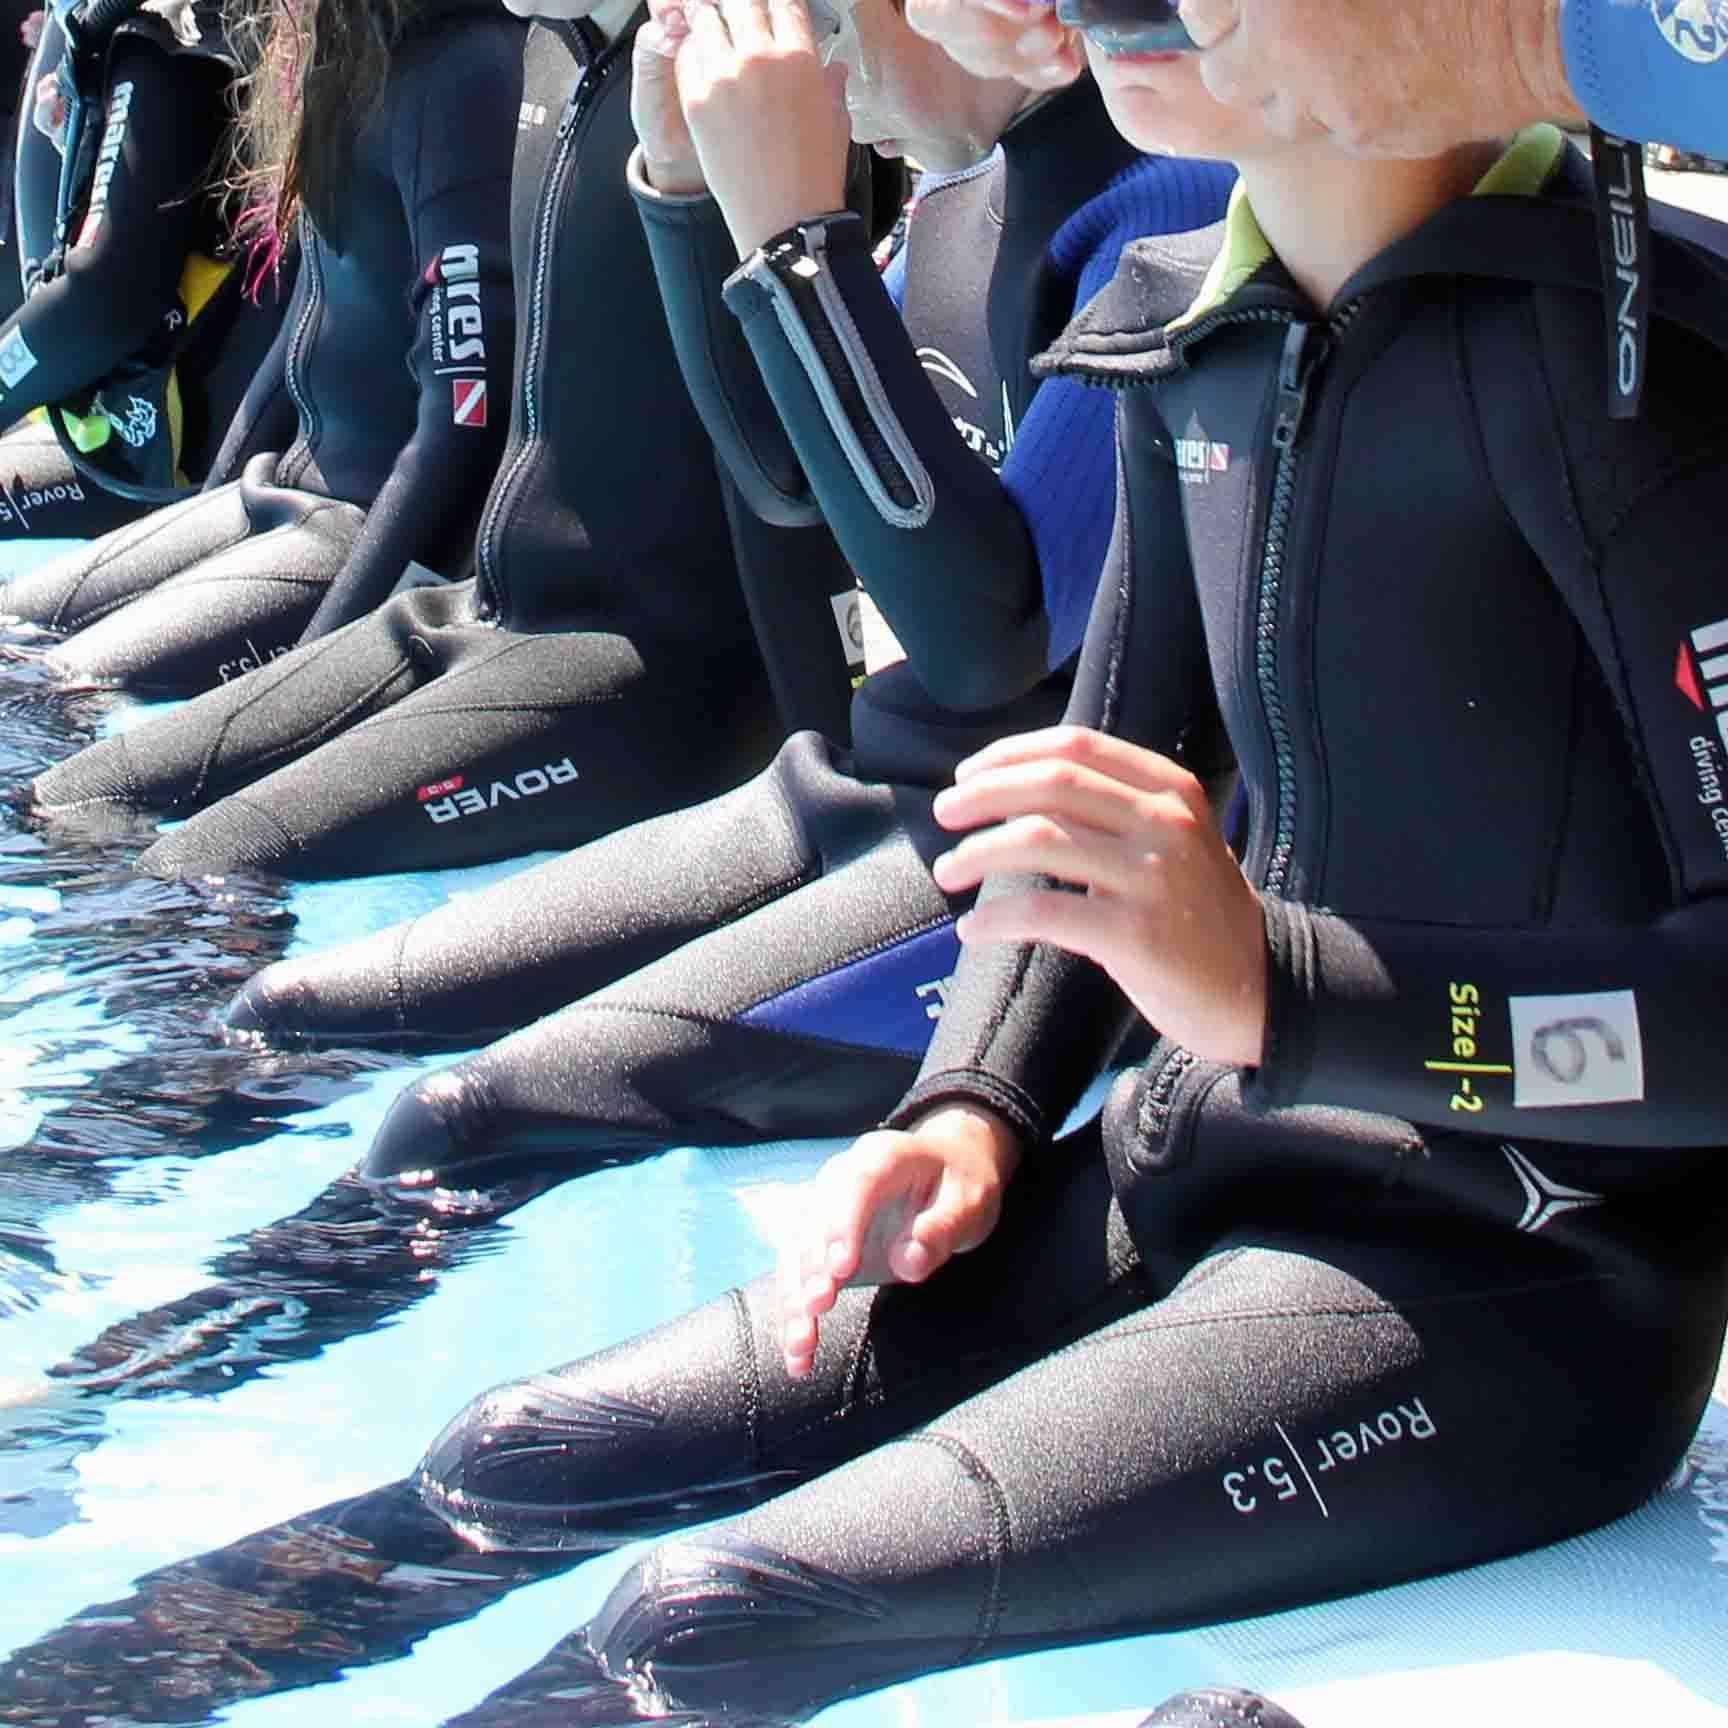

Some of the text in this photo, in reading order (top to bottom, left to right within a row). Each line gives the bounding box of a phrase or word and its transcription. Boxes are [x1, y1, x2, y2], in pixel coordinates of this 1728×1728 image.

[431, 315, 444, 363] center
[21, 481, 85, 511] Rover
[423, 757, 579, 824] ROVER
[1689, 734, 1723, 805] diving
[1449, 980, 1481, 1059] Size
[1222, 1396, 1437, 1513] Rover 5.3
